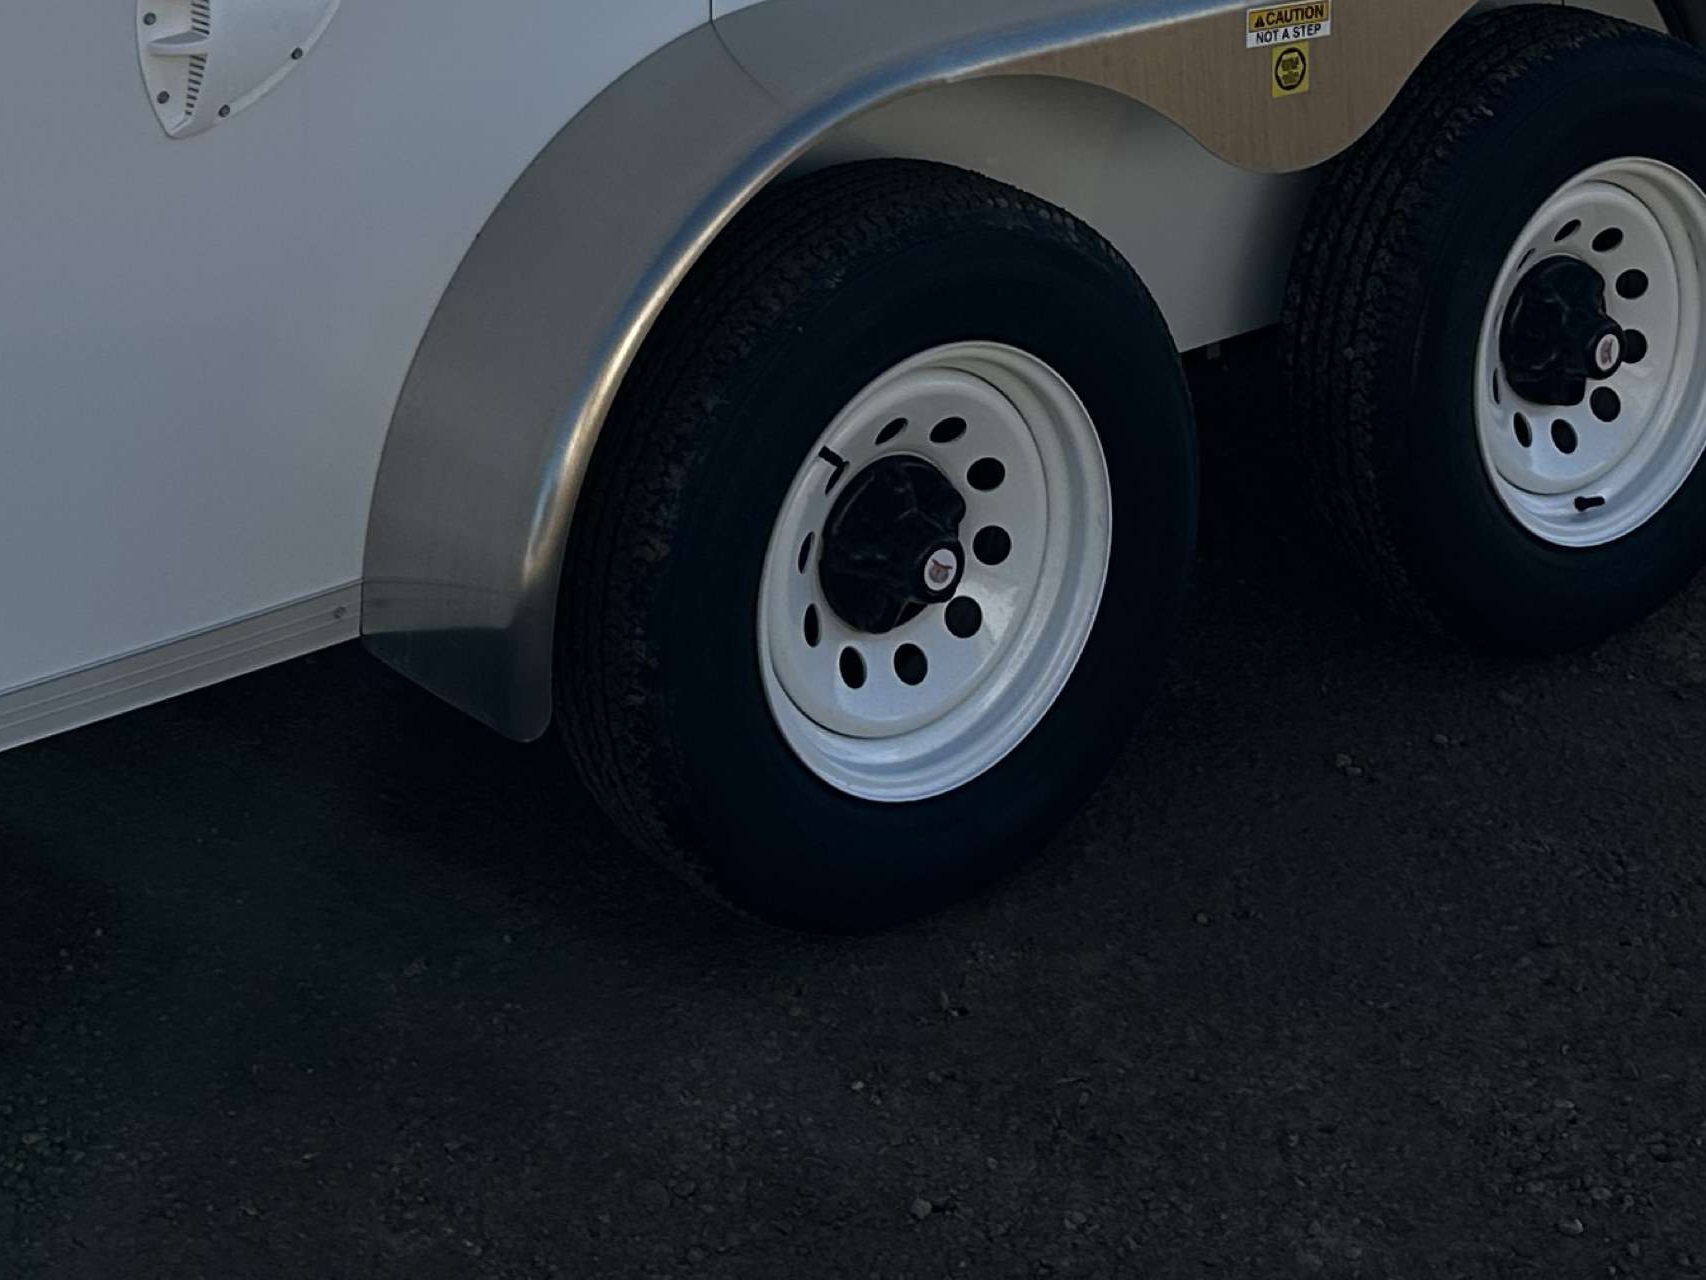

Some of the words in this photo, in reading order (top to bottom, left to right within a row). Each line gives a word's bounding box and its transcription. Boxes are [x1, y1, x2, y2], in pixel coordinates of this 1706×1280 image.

[1266, 4, 1324, 25] CAUTION
[1256, 29, 1278, 44] NOT
[1282, 27, 1290, 40] A
[1293, 23, 1321, 38] STEP
